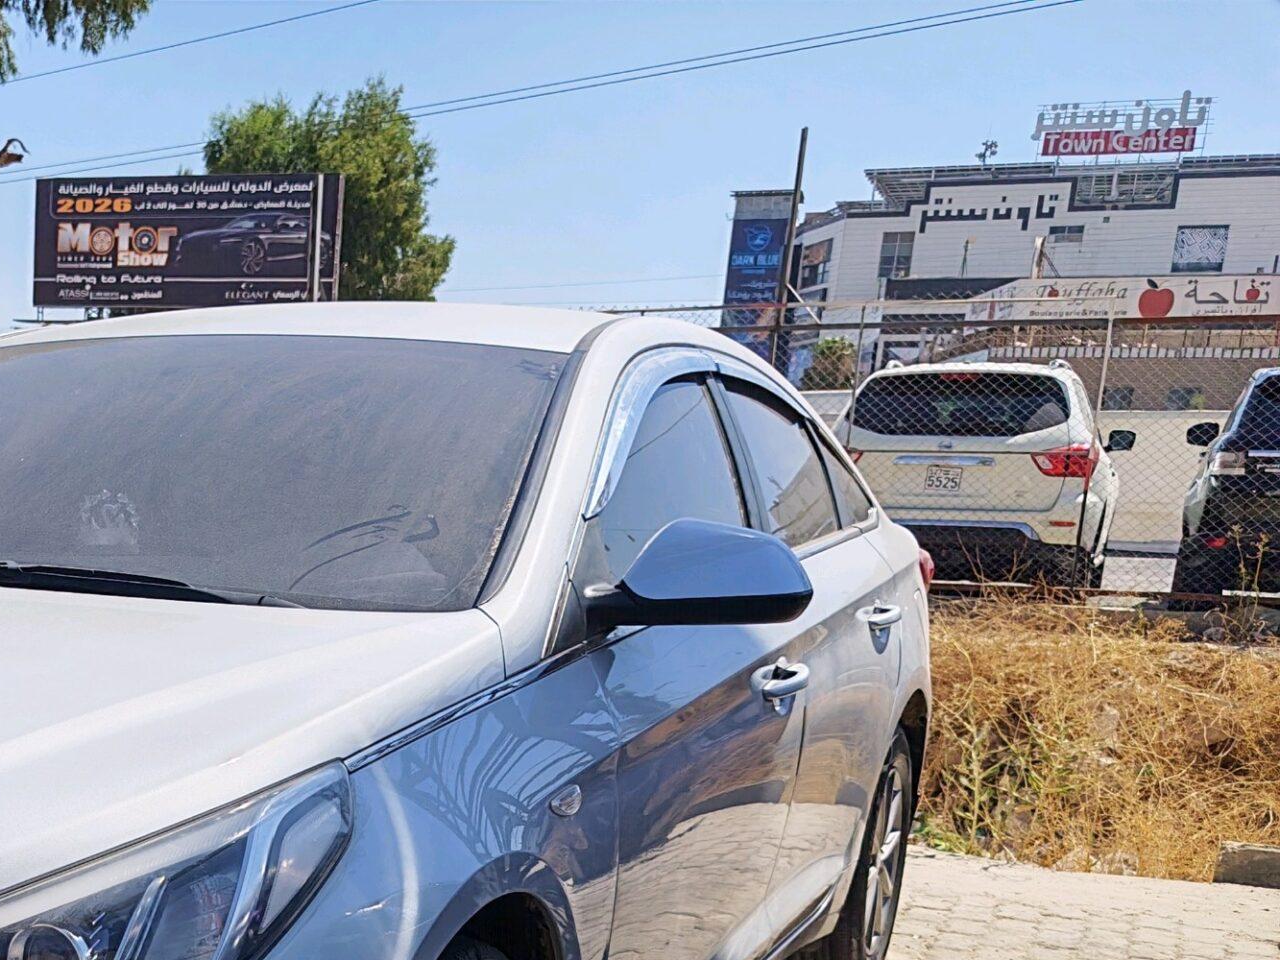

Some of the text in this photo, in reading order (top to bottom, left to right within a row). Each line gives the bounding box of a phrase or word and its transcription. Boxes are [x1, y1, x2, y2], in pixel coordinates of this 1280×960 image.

[1031, 89, 1212, 140] تاون سنتر
[1045, 132, 1195, 153] Town Center
[58, 182, 103, 196] والصيانة
[146, 182, 179, 195] وقطع
[181, 180, 230, 195] للسيارات
[232, 180, 271, 195] الدولي
[274, 181, 314, 193] لمعرض
[56, 197, 132, 213] 2026
[919, 194, 1059, 233] تاون سنتر
[57, 222, 178, 255] Motor
[225, 291, 270, 299] ELEGANT
[927, 476, 958, 489] 5525
